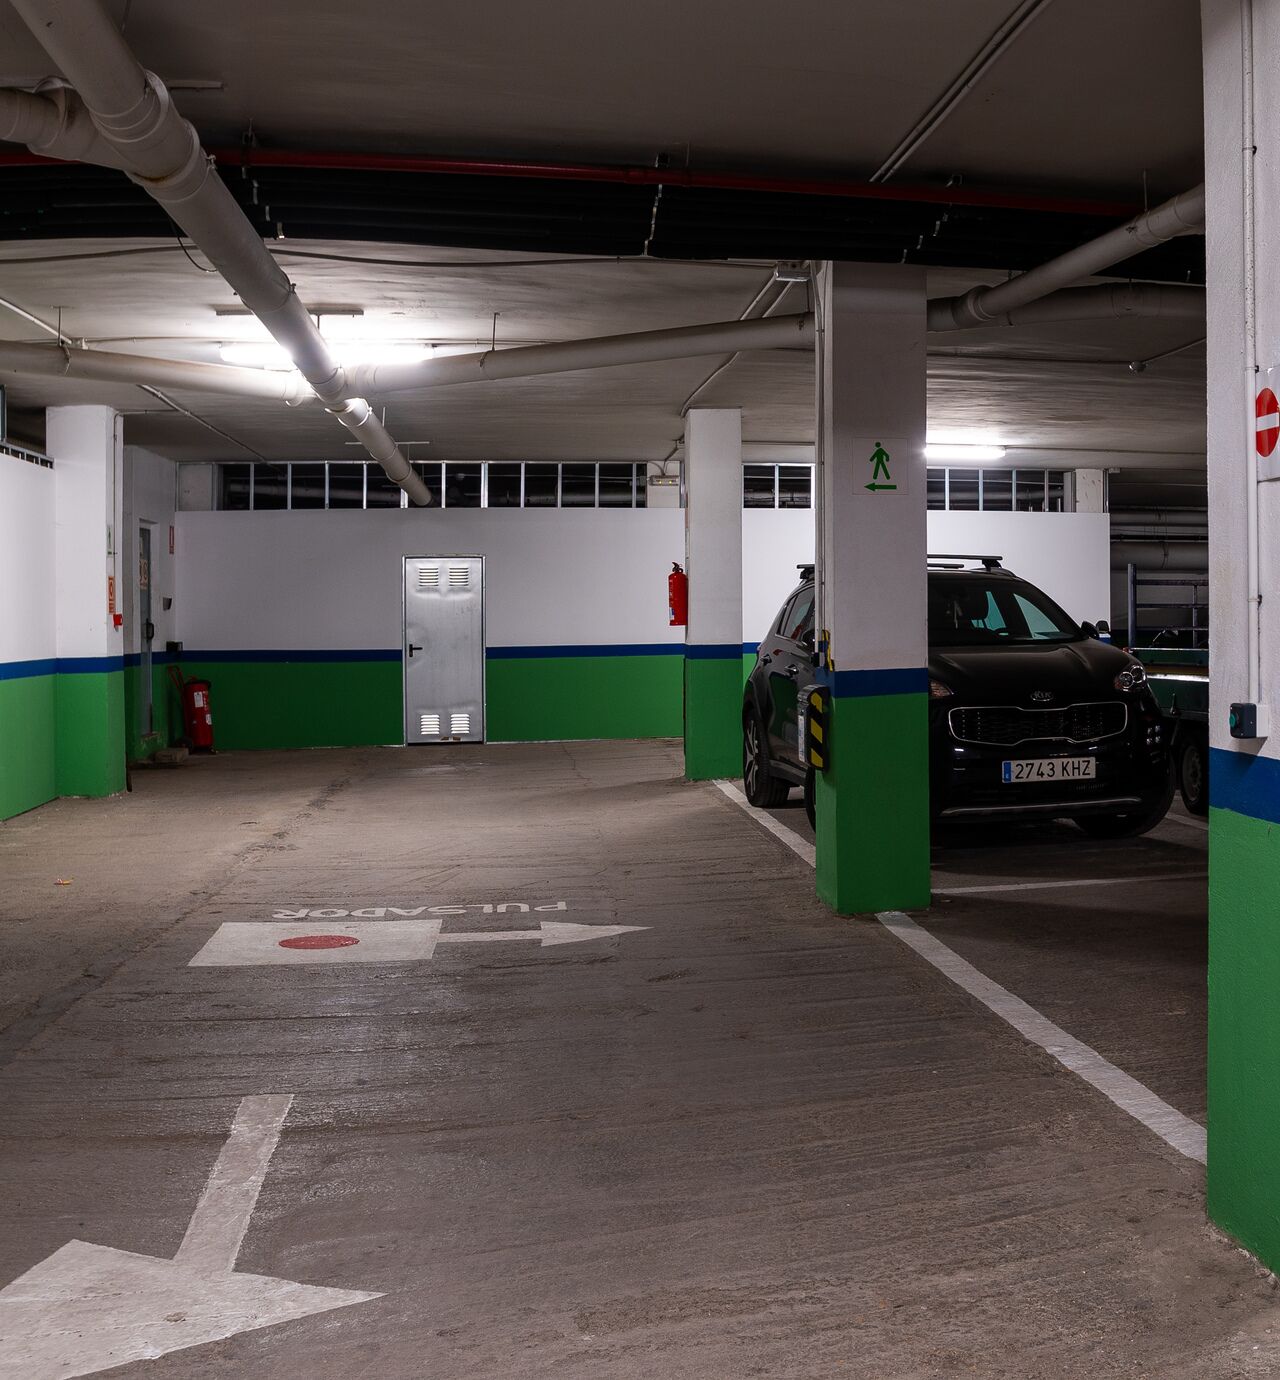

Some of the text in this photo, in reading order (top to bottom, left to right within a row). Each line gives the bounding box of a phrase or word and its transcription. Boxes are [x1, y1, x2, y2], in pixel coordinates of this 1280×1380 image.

[1015, 760, 1091, 780] 2743 KHZ
[272, 902, 567, 919] PULSADOR
